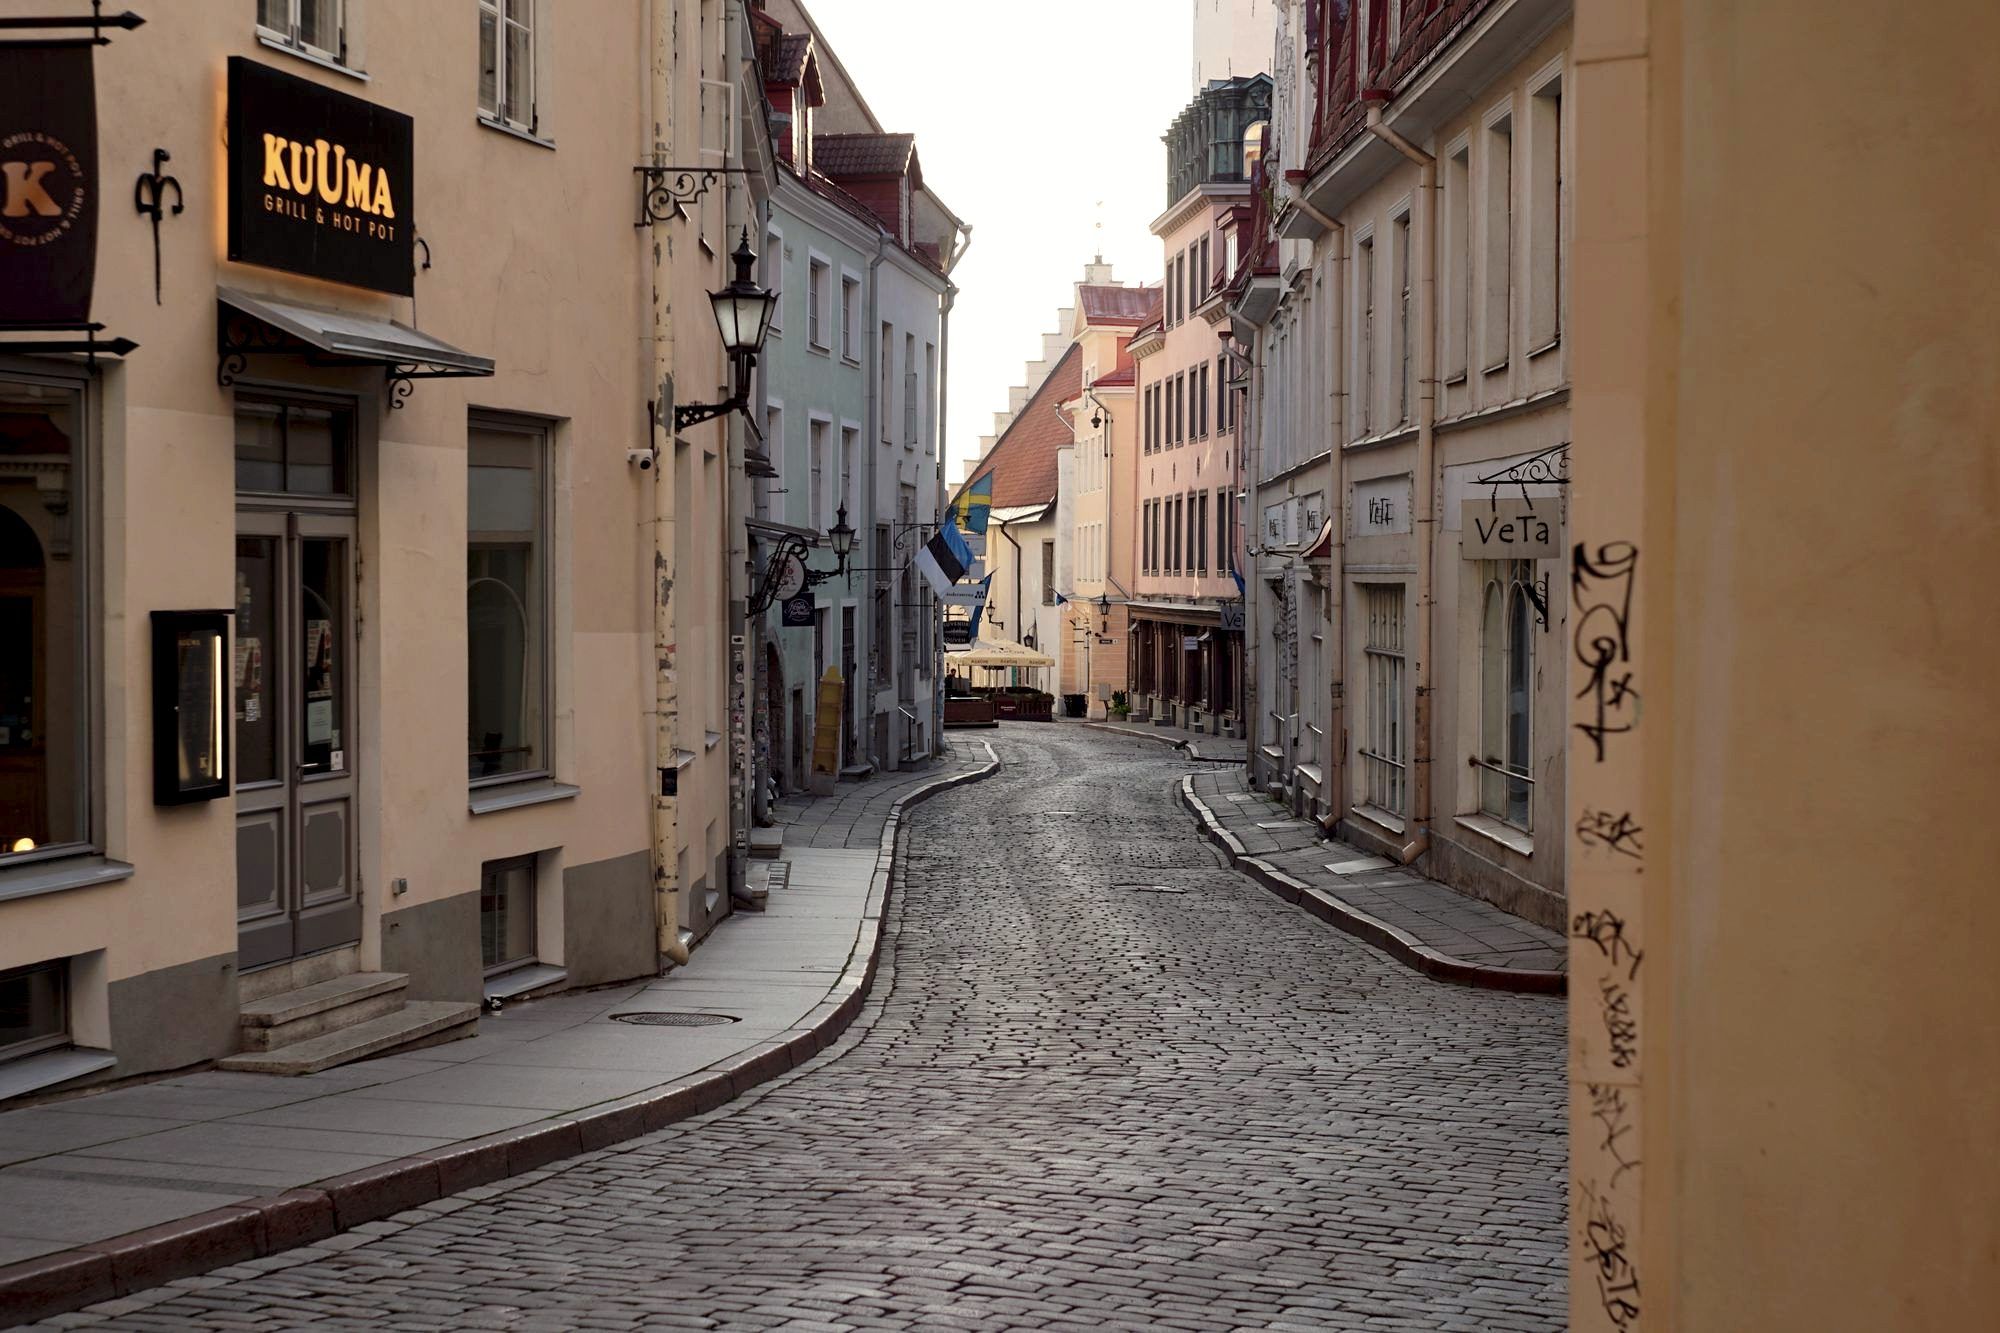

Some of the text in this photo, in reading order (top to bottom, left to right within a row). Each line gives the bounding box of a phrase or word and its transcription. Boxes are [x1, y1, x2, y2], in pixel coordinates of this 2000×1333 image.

[2, 161, 62, 217] K
[263, 132, 395, 219] KUUMA
[264, 194, 395, 242] GRILL & HOT POT
[1475, 515, 1549, 545] VeTa
[1224, 612, 1246, 627] VeT
